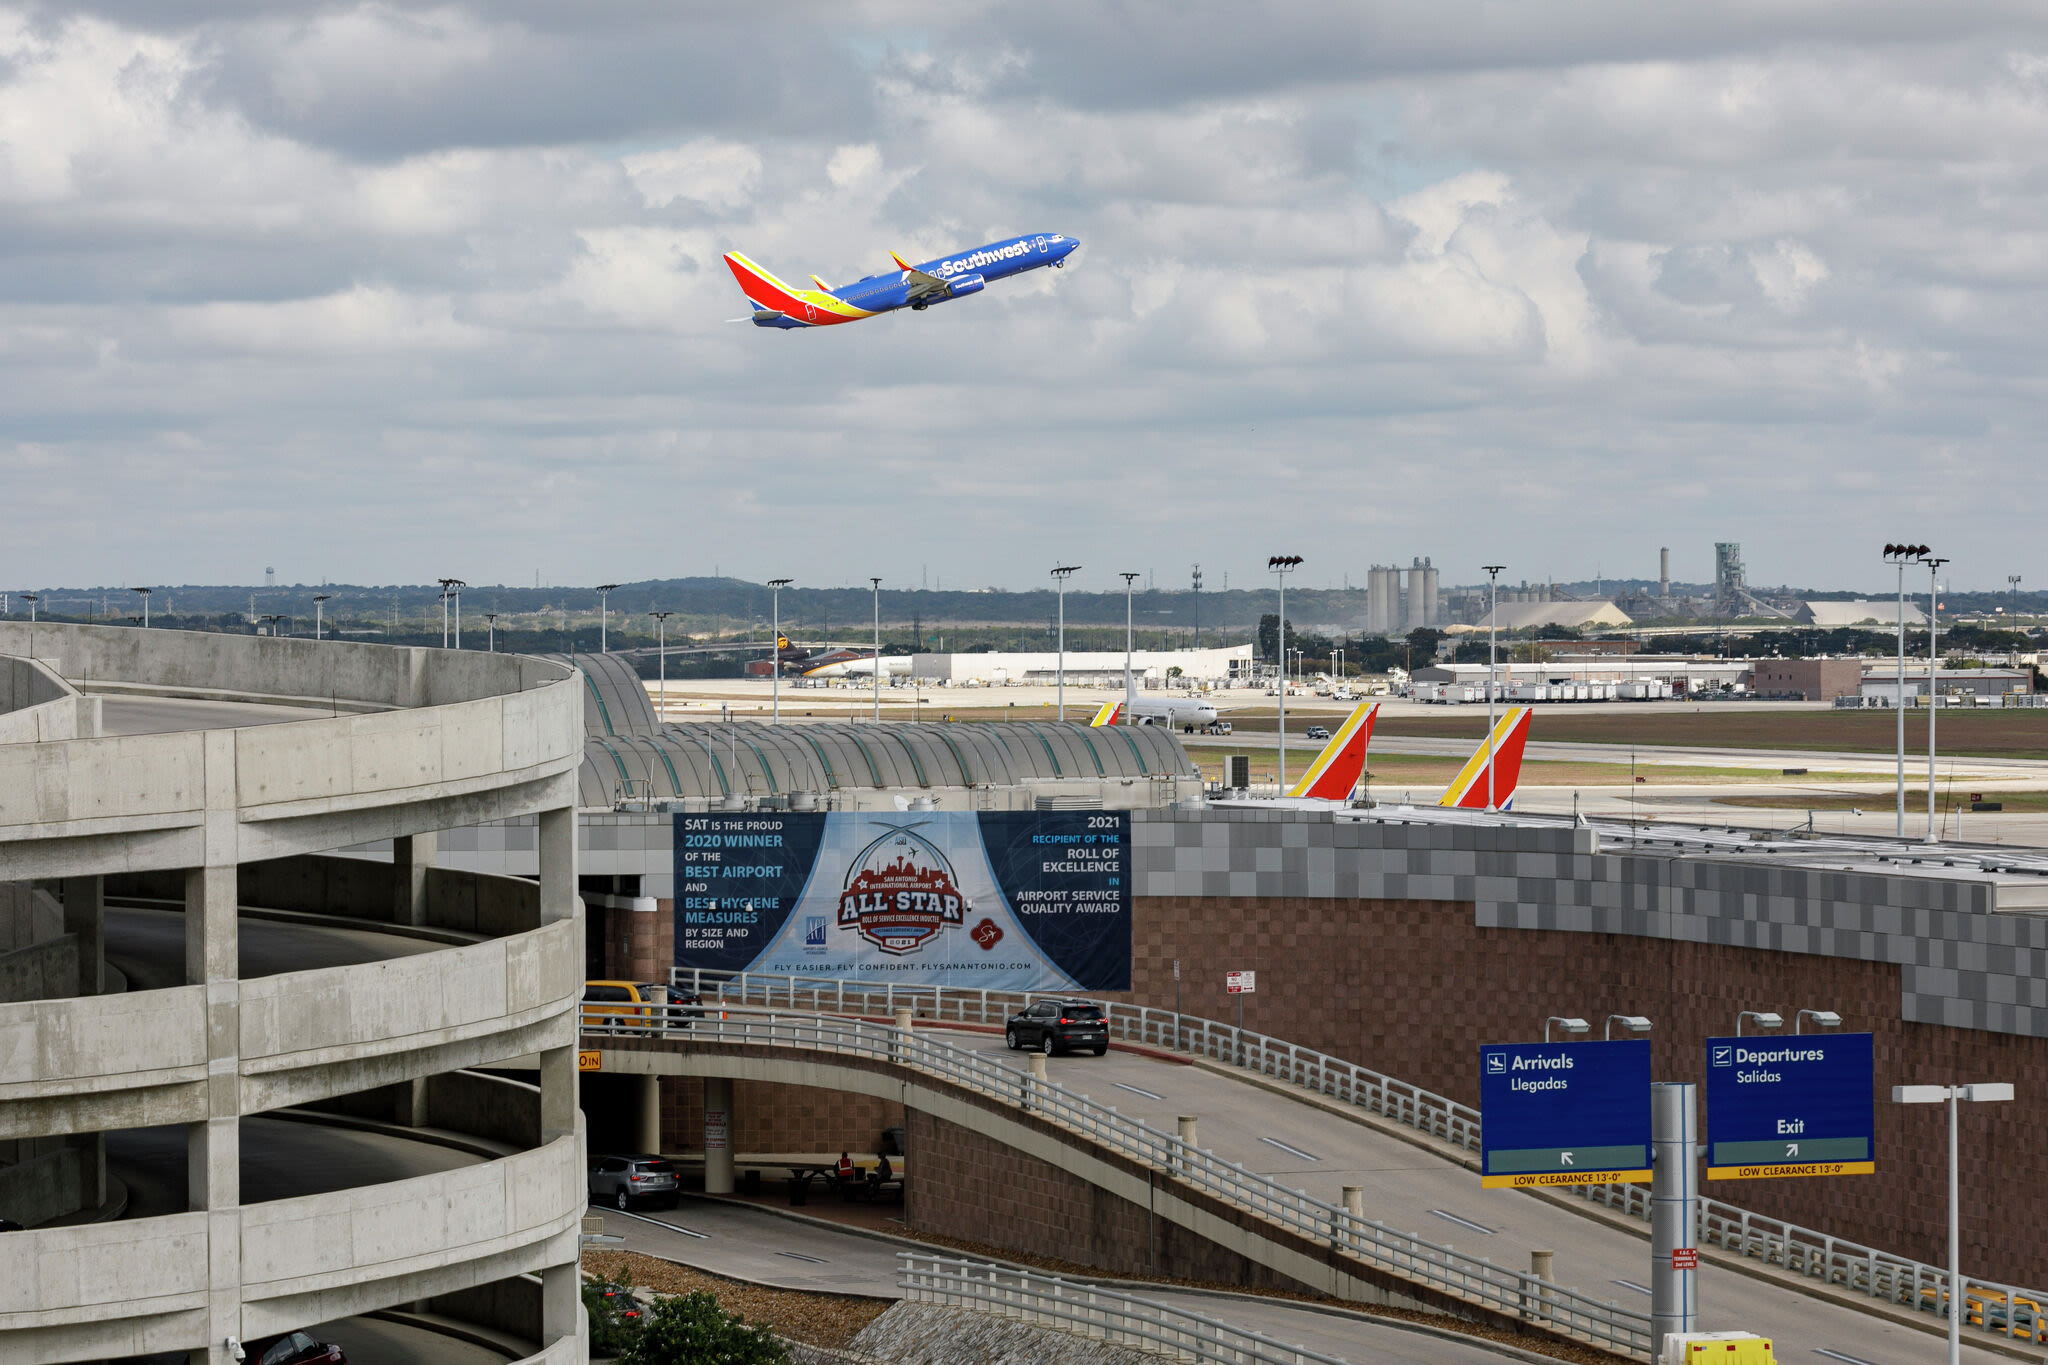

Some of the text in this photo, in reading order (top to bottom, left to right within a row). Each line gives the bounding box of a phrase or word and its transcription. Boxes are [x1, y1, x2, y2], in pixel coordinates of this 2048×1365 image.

[941, 240, 1030, 276] Southwest
[684, 819, 783, 830] SAT IS THE PROUD
[1088, 816, 1120, 828] 2021
[685, 835, 783, 847] 2020 WINNER
[1032, 835, 1119, 844] RECIPIENT OF THE
[684, 852, 721, 861] OF THE
[1067, 848, 1119, 859] ROLL OF
[685, 866, 783, 878] BEST AIRPORT
[1042, 862, 1120, 872] EXCELLENCE
[1108, 877, 1119, 886] IN
[685, 883, 708, 892] AND
[1016, 891, 1120, 901] AIRPORT SERVICE
[841, 892, 960, 920] ALL STAR
[1020, 903, 1120, 914] QUALITY AWARD
[685, 912, 758, 924] MEASURES
[685, 928, 749, 937] BY SIZE AND
[685, 940, 724, 949] REGION
[588, 1056, 598, 1066] IN
[1511, 1053, 1574, 1070] Arrivals
[1736, 1048, 1824, 1066] Departures
[1737, 1070, 1781, 1083] Salidas
[1511, 1077, 1568, 1093] Llegadas
[1777, 1118, 1804, 1134] Exit
[1739, 1168, 1760, 1177] LOW
[1763, 1166, 1816, 1176] CLEARANCE
[1514, 1176, 1535, 1185] LOW
[1538, 1174, 1593, 1184] CLEARANCE
